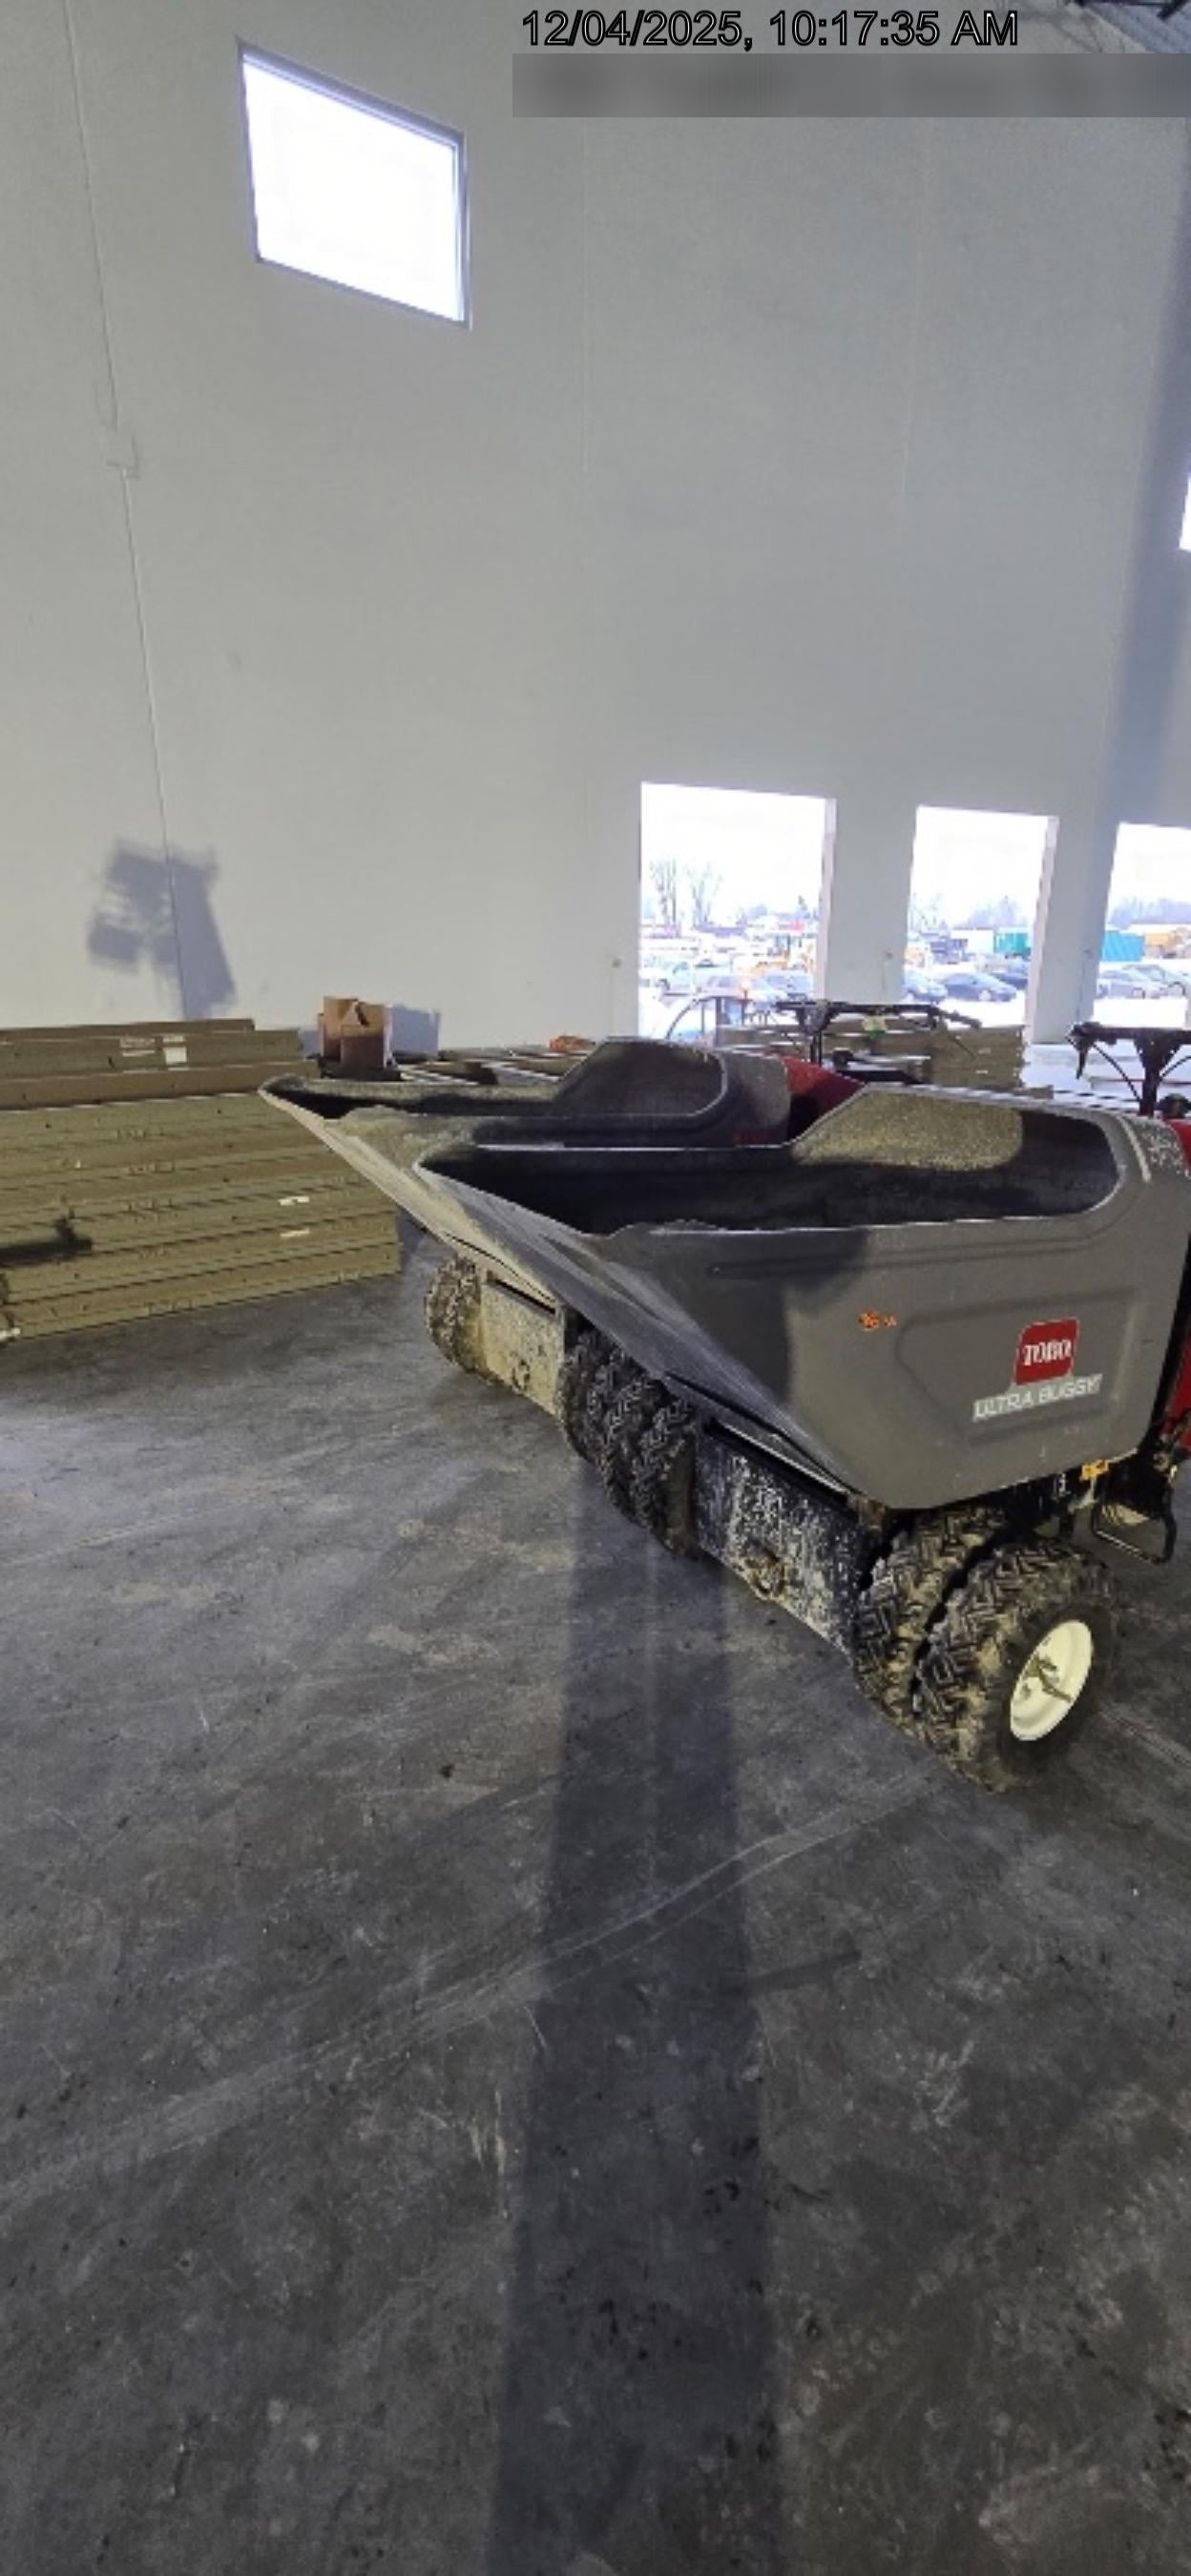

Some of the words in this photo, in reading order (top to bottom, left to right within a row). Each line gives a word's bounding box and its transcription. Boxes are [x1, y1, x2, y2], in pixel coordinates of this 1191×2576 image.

[1024, 1339, 1072, 1366] TORO
[974, 1393, 1034, 1419] ULTRA
[1038, 1375, 1100, 1403] BUGGY
